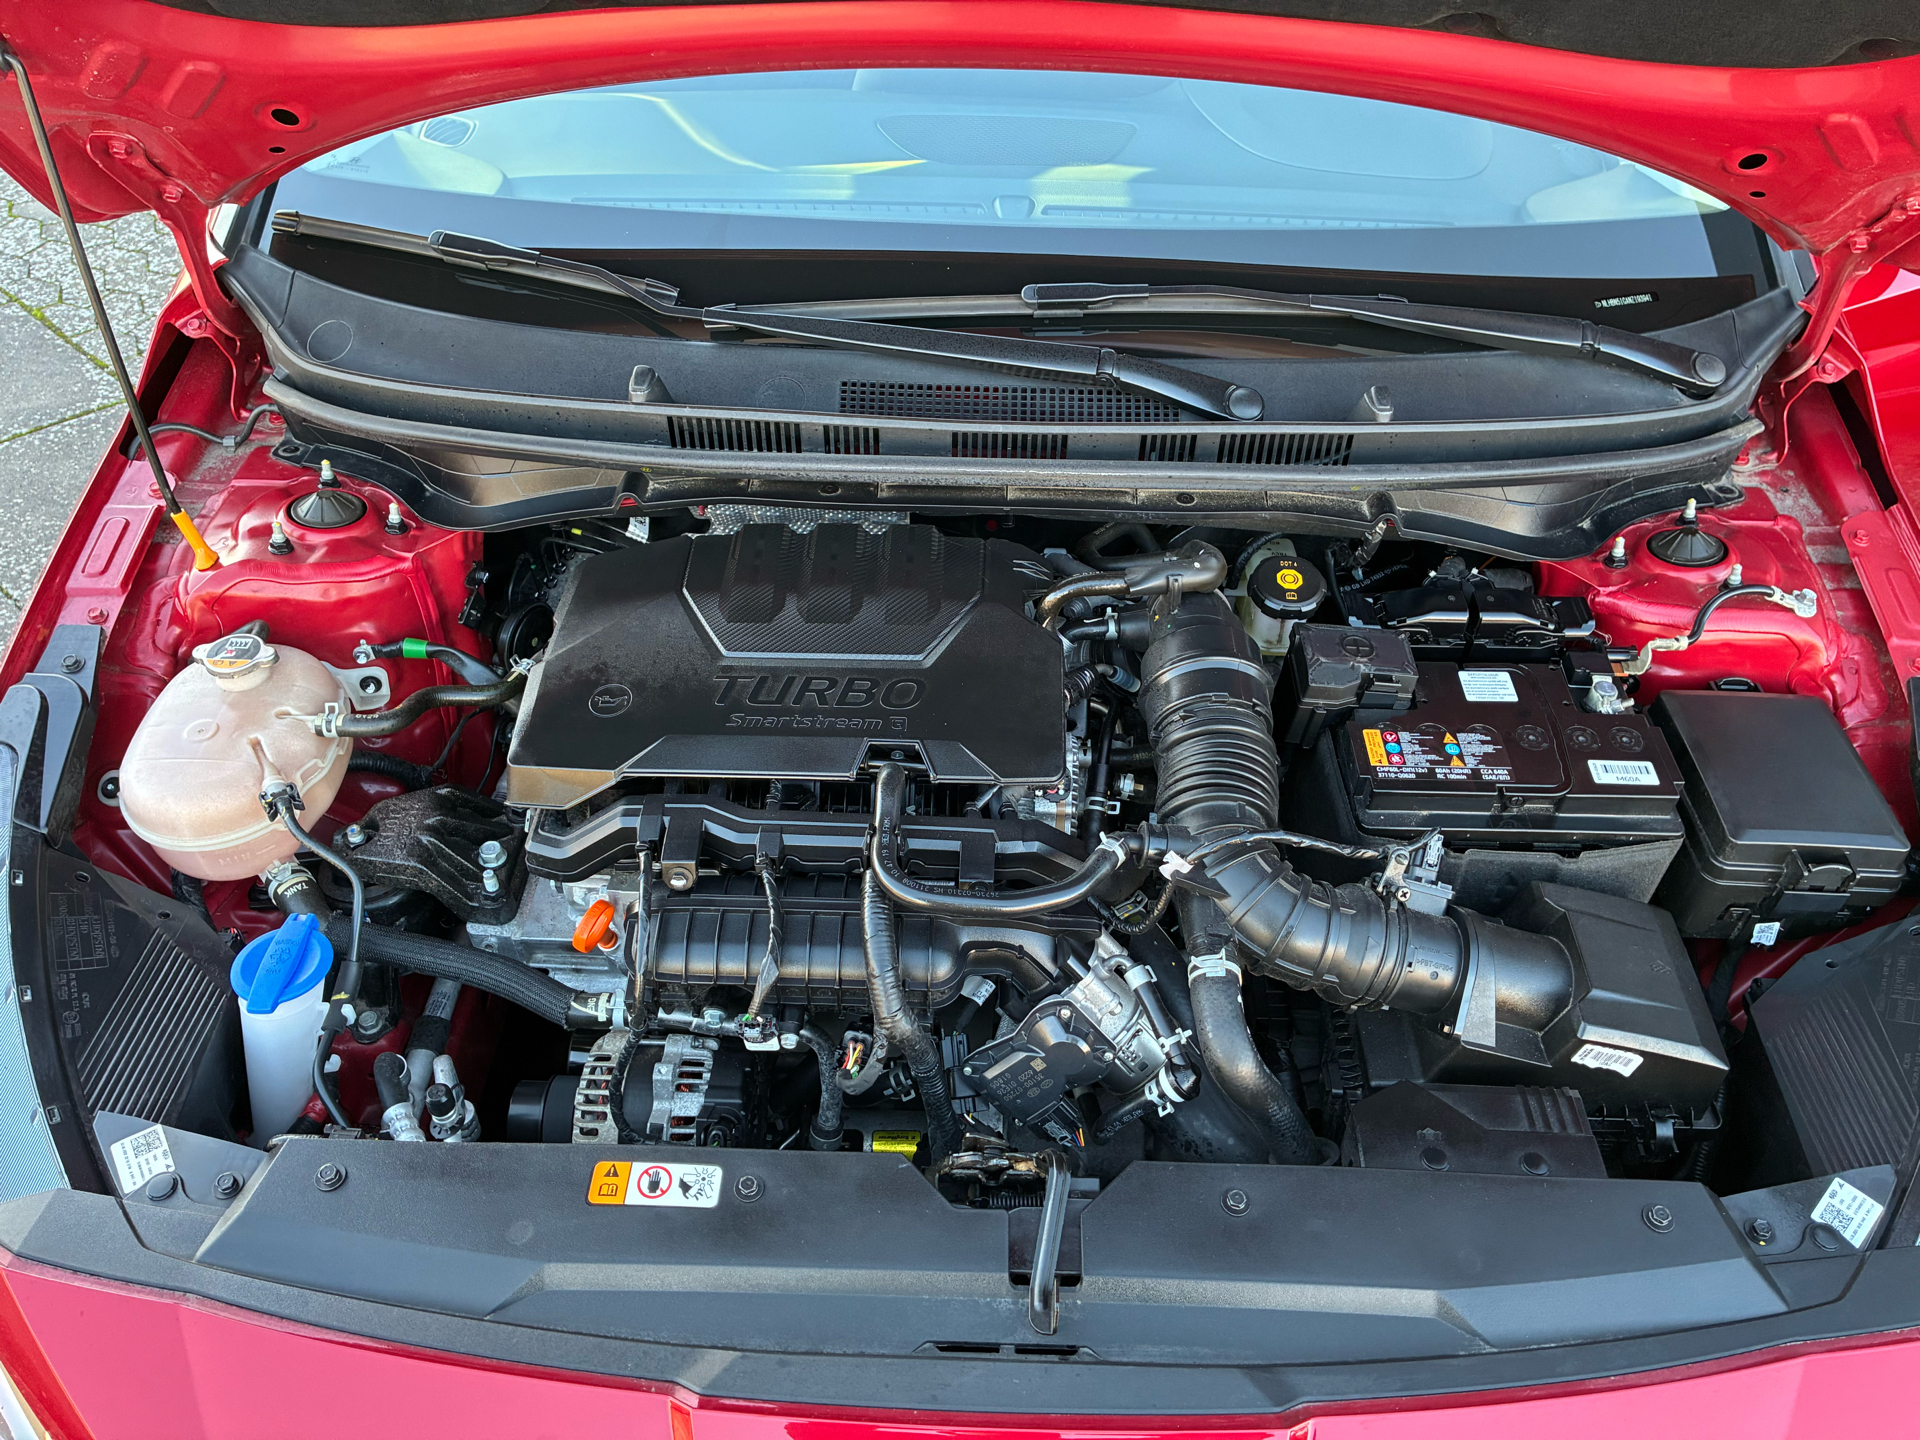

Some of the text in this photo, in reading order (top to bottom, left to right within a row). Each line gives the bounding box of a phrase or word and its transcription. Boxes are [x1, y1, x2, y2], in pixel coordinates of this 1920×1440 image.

[713, 675, 927, 710] TURBO
[726, 713, 883, 730] Smartstream
[284, 882, 309, 898] TANK
